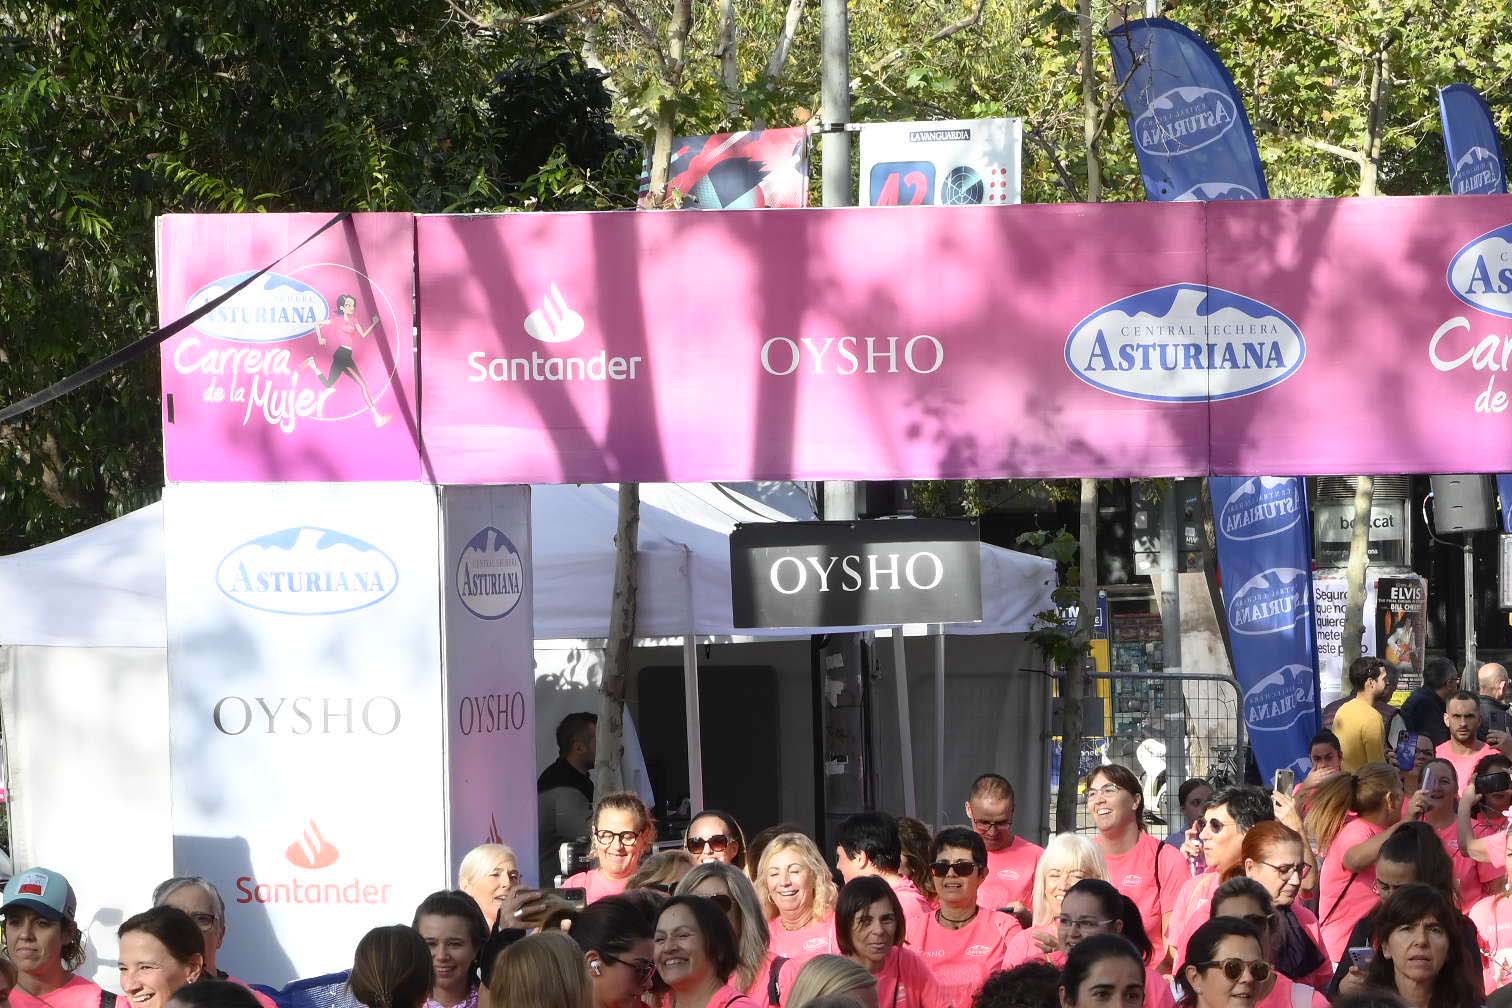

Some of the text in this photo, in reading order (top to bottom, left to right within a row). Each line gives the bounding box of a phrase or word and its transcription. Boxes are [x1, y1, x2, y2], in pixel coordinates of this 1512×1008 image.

[1120, 322, 1280, 337] CENTRAL LECHERA
[173, 337, 292, 374] Carrera
[467, 350, 643, 382] Santander
[760, 334, 945, 376] OYSHO
[1084, 329, 1288, 371] ASTURIANA
[204, 372, 337, 433] de la Mujer
[1474, 374, 1508, 413] de
[229, 560, 386, 593] ASTURIANA
[462, 562, 520, 597] ASTURIANA
[770, 551, 944, 595] OYSHO
[1391, 587, 1421, 600] ELVIS
[1316, 618, 1347, 635] quiere
[213, 696, 401, 736] OYSHO
[459, 691, 525, 736] OYSHO
[236, 876, 392, 904] Santander
